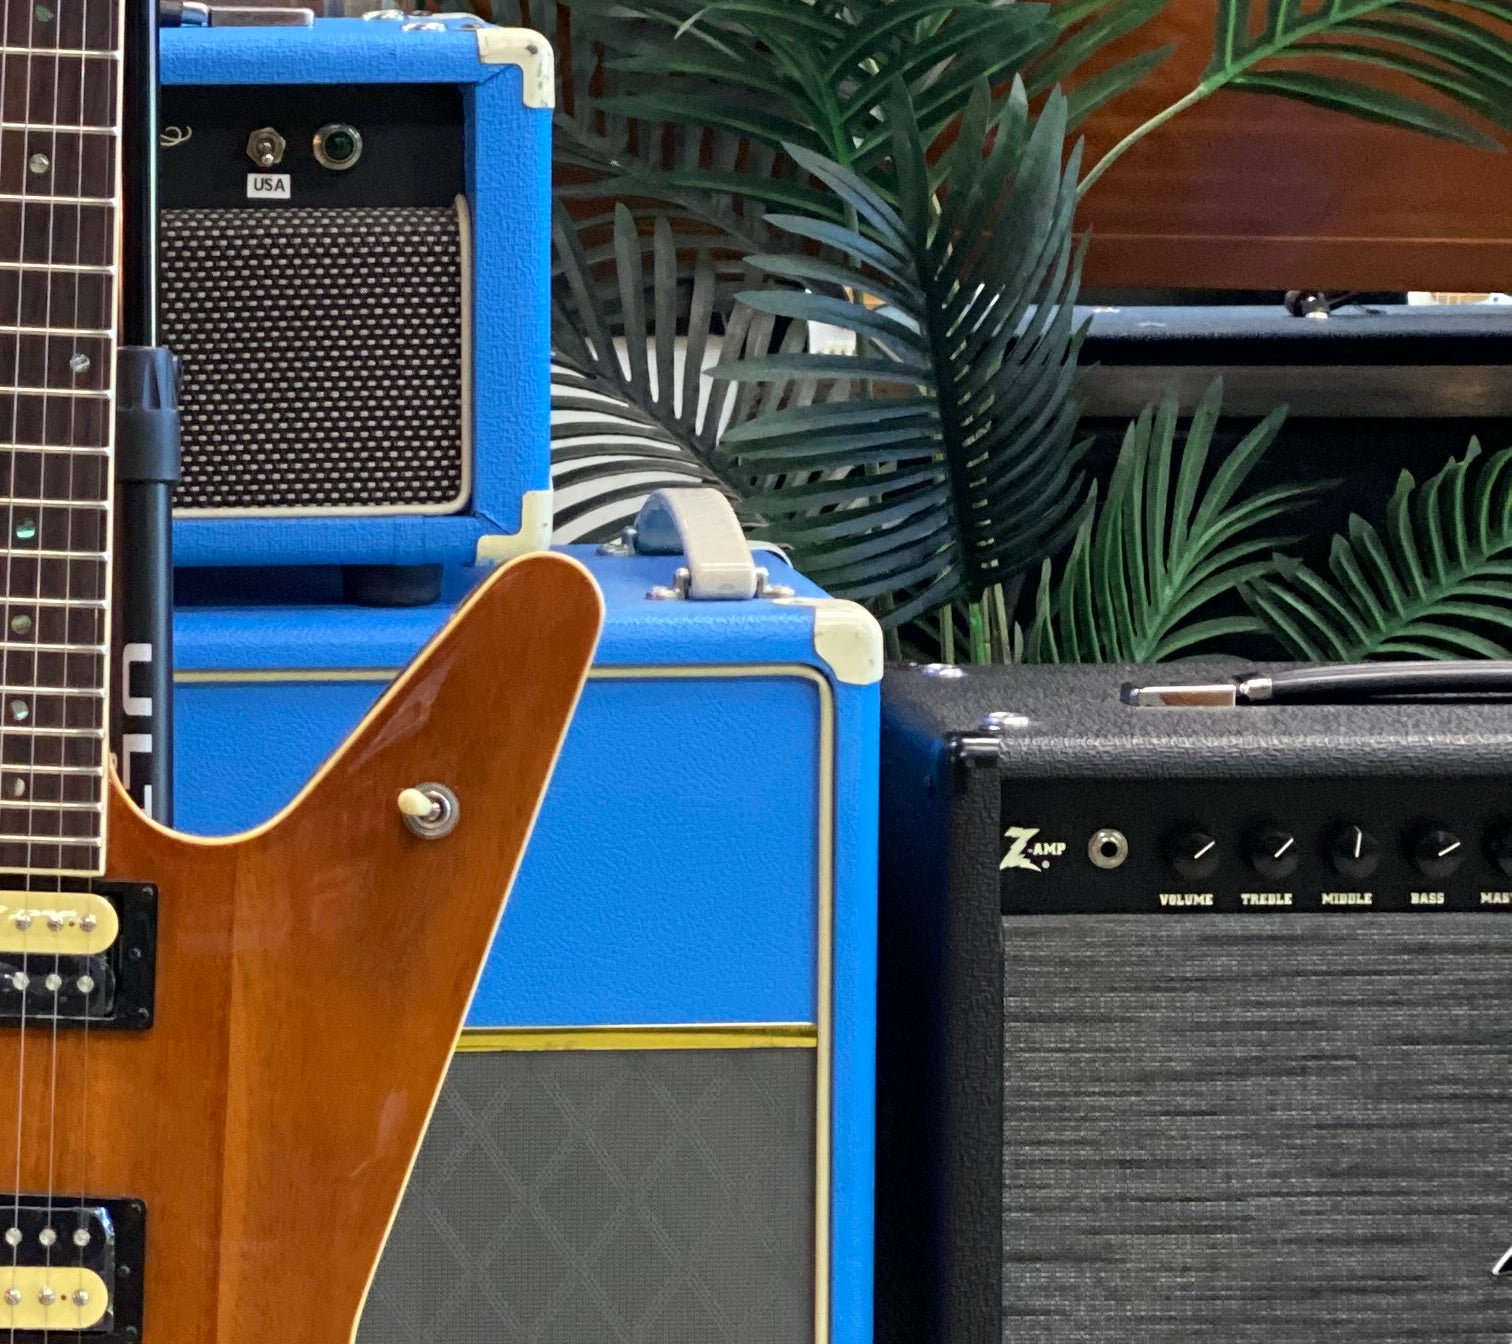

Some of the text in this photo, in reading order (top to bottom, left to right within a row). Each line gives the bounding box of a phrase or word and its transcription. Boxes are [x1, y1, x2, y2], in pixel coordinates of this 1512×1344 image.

[253, 177, 286, 193] USA
[1159, 893, 1214, 906] VOLUME
[1241, 892, 1293, 905] TREBLE
[1321, 892, 1373, 905] MIDDLE
[1410, 892, 1445, 905] BASS
